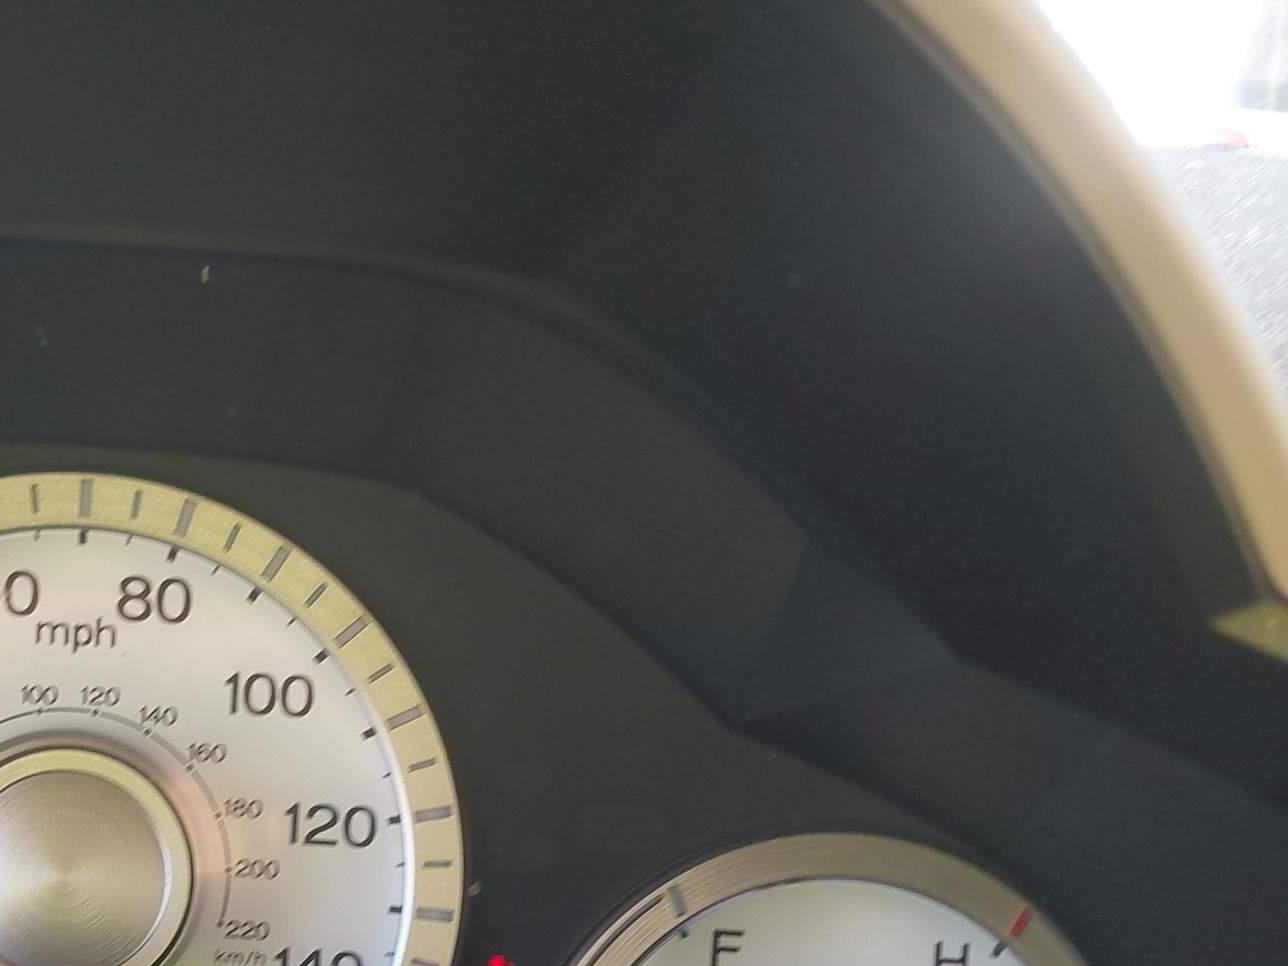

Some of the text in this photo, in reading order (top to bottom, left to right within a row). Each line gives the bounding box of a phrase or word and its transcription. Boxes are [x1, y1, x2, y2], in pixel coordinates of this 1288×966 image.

[117, 576, 192, 624] 80
[35, 618, 116, 653] mph
[20, 685, 59, 706] 100
[80, 686, 121, 707] 120
[224, 672, 313, 719] 100
[139, 705, 178, 728] 140
[187, 742, 227, 764] 160
[222, 798, 264, 819] 180
[284, 802, 376, 848] 120
[234, 859, 280, 881] 200
[224, 920, 270, 941] 220
